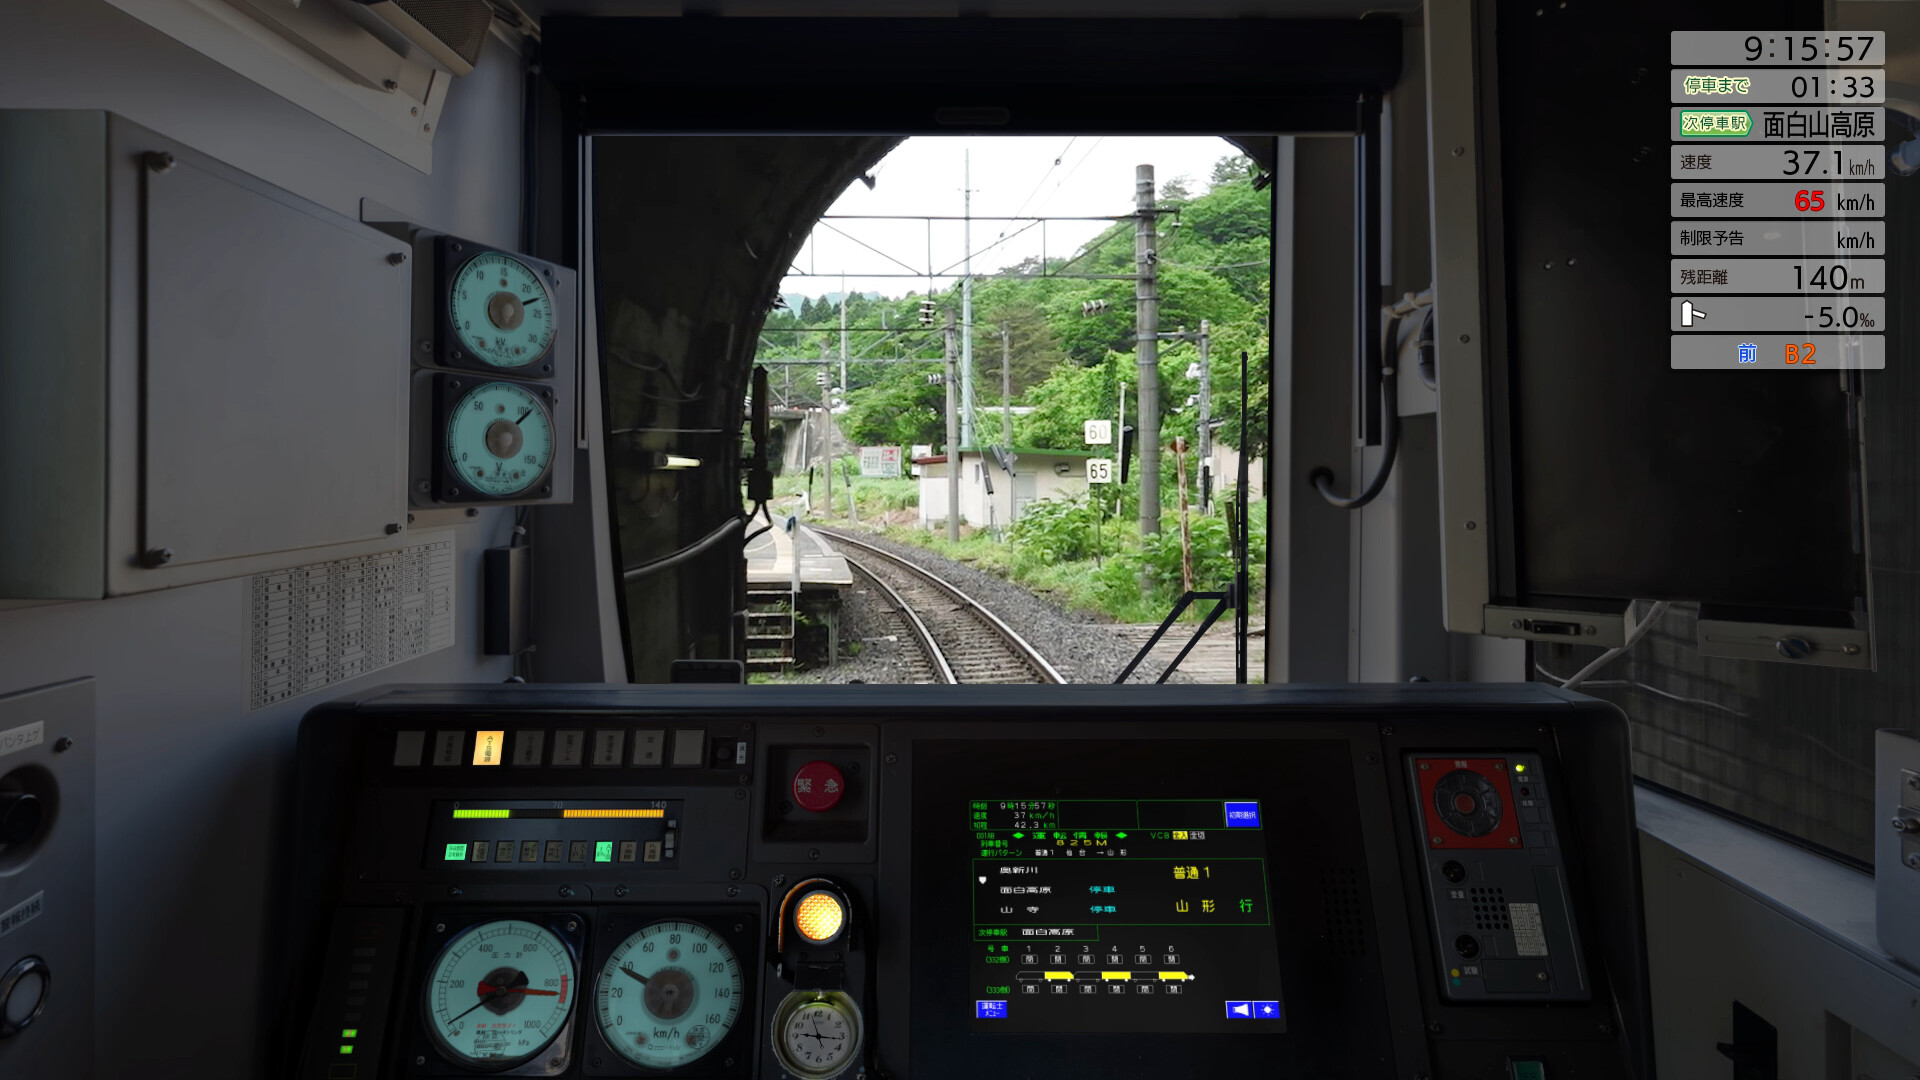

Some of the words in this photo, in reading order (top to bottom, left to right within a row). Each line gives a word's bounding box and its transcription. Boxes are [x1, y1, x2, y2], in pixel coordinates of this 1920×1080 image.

[476, 270, 484, 281] 10
[500, 267, 508, 277] 15
[522, 284, 531, 294] 20
[533, 309, 542, 319] 25
[528, 334, 537, 344] 30
[474, 401, 484, 411] 50
[517, 406, 529, 416] 100
[1089, 425, 1107, 439] 60
[523, 456, 536, 465] 150
[1090, 464, 1108, 479] 65
[797, 778, 839, 793] 緊急
[1029, 812, 1055, 820] km/h
[1014, 821, 1039, 829] 42.3
[1043, 821, 1055, 829] km
[1000, 866, 1038, 874] 奥新川
[1000, 886, 1052, 894] 面白高原
[1089, 885, 1116, 894] 停車
[1090, 905, 1117, 914] 停車
[1021, 928, 1075, 936] 面白高原
[669, 934, 681, 944] 80
[478, 943, 493, 953] 400
[522, 943, 538, 953] 600
[642, 943, 654, 953] 60
[692, 943, 708, 953] 100
[1026, 945, 1032, 953] 1
[1055, 945, 1061, 953] 2
[1083, 945, 1089, 953] 3
[1111, 945, 1118, 953] 4
[1140, 945, 1146, 953] 5
[1168, 945, 1174, 953] 6
[622, 961, 634, 971] 40
[709, 962, 724, 973] 120
[449, 979, 464, 989] 200
[544, 978, 558, 987] 800
[611, 987, 623, 998] 20
[714, 988, 730, 998] 140
[616, 1016, 623, 1026] 0
[705, 1014, 721, 1024] 160
[459, 1021, 464, 1029] 0
[523, 1020, 541, 1029] 1000
[653, 1027, 680, 1040] km/h
[796, 1043, 803, 1052] 8
[815, 1055, 822, 1063] 6
